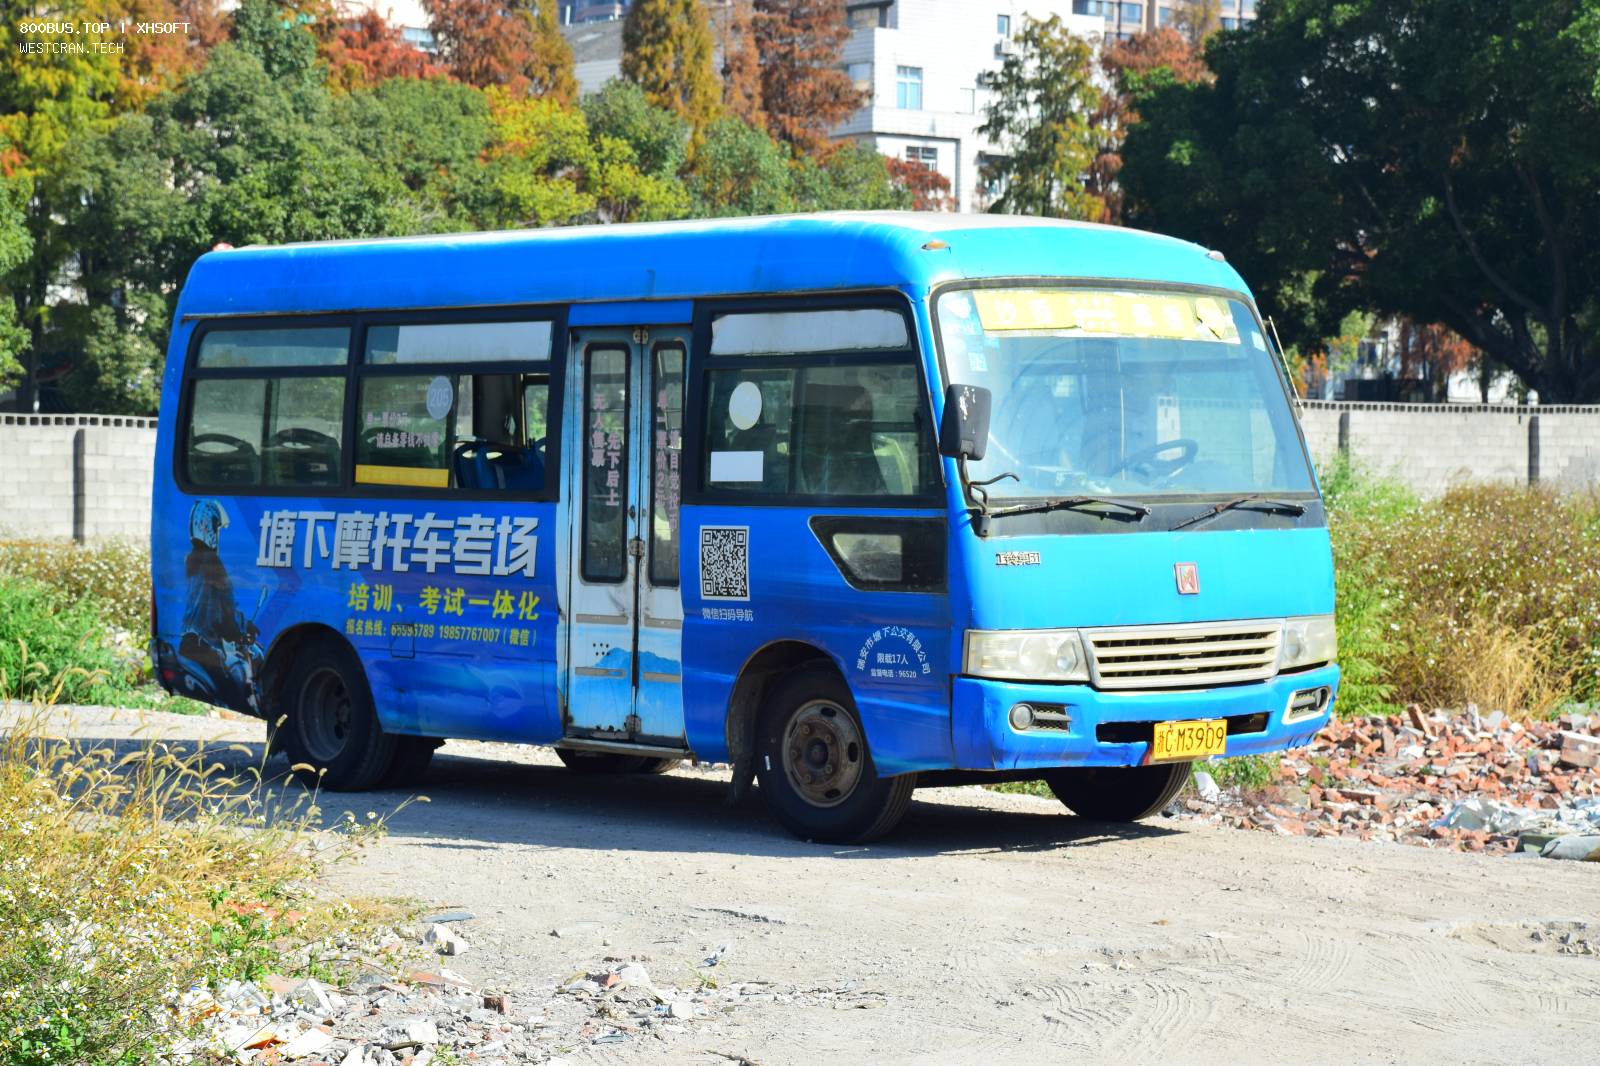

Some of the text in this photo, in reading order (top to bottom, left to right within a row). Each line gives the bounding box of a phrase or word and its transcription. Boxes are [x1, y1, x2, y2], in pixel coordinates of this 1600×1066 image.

[606, 433, 620, 506] 先下后上
[256, 509, 540, 578] 塘下摩托车考场
[347, 582, 540, 621] 培训、考试一体化
[702, 607, 754, 622] 微信扫码导航
[857, 626, 931, 674] 瑞安市塘下公交有限公司
[876, 652, 909, 665] 限载17人
